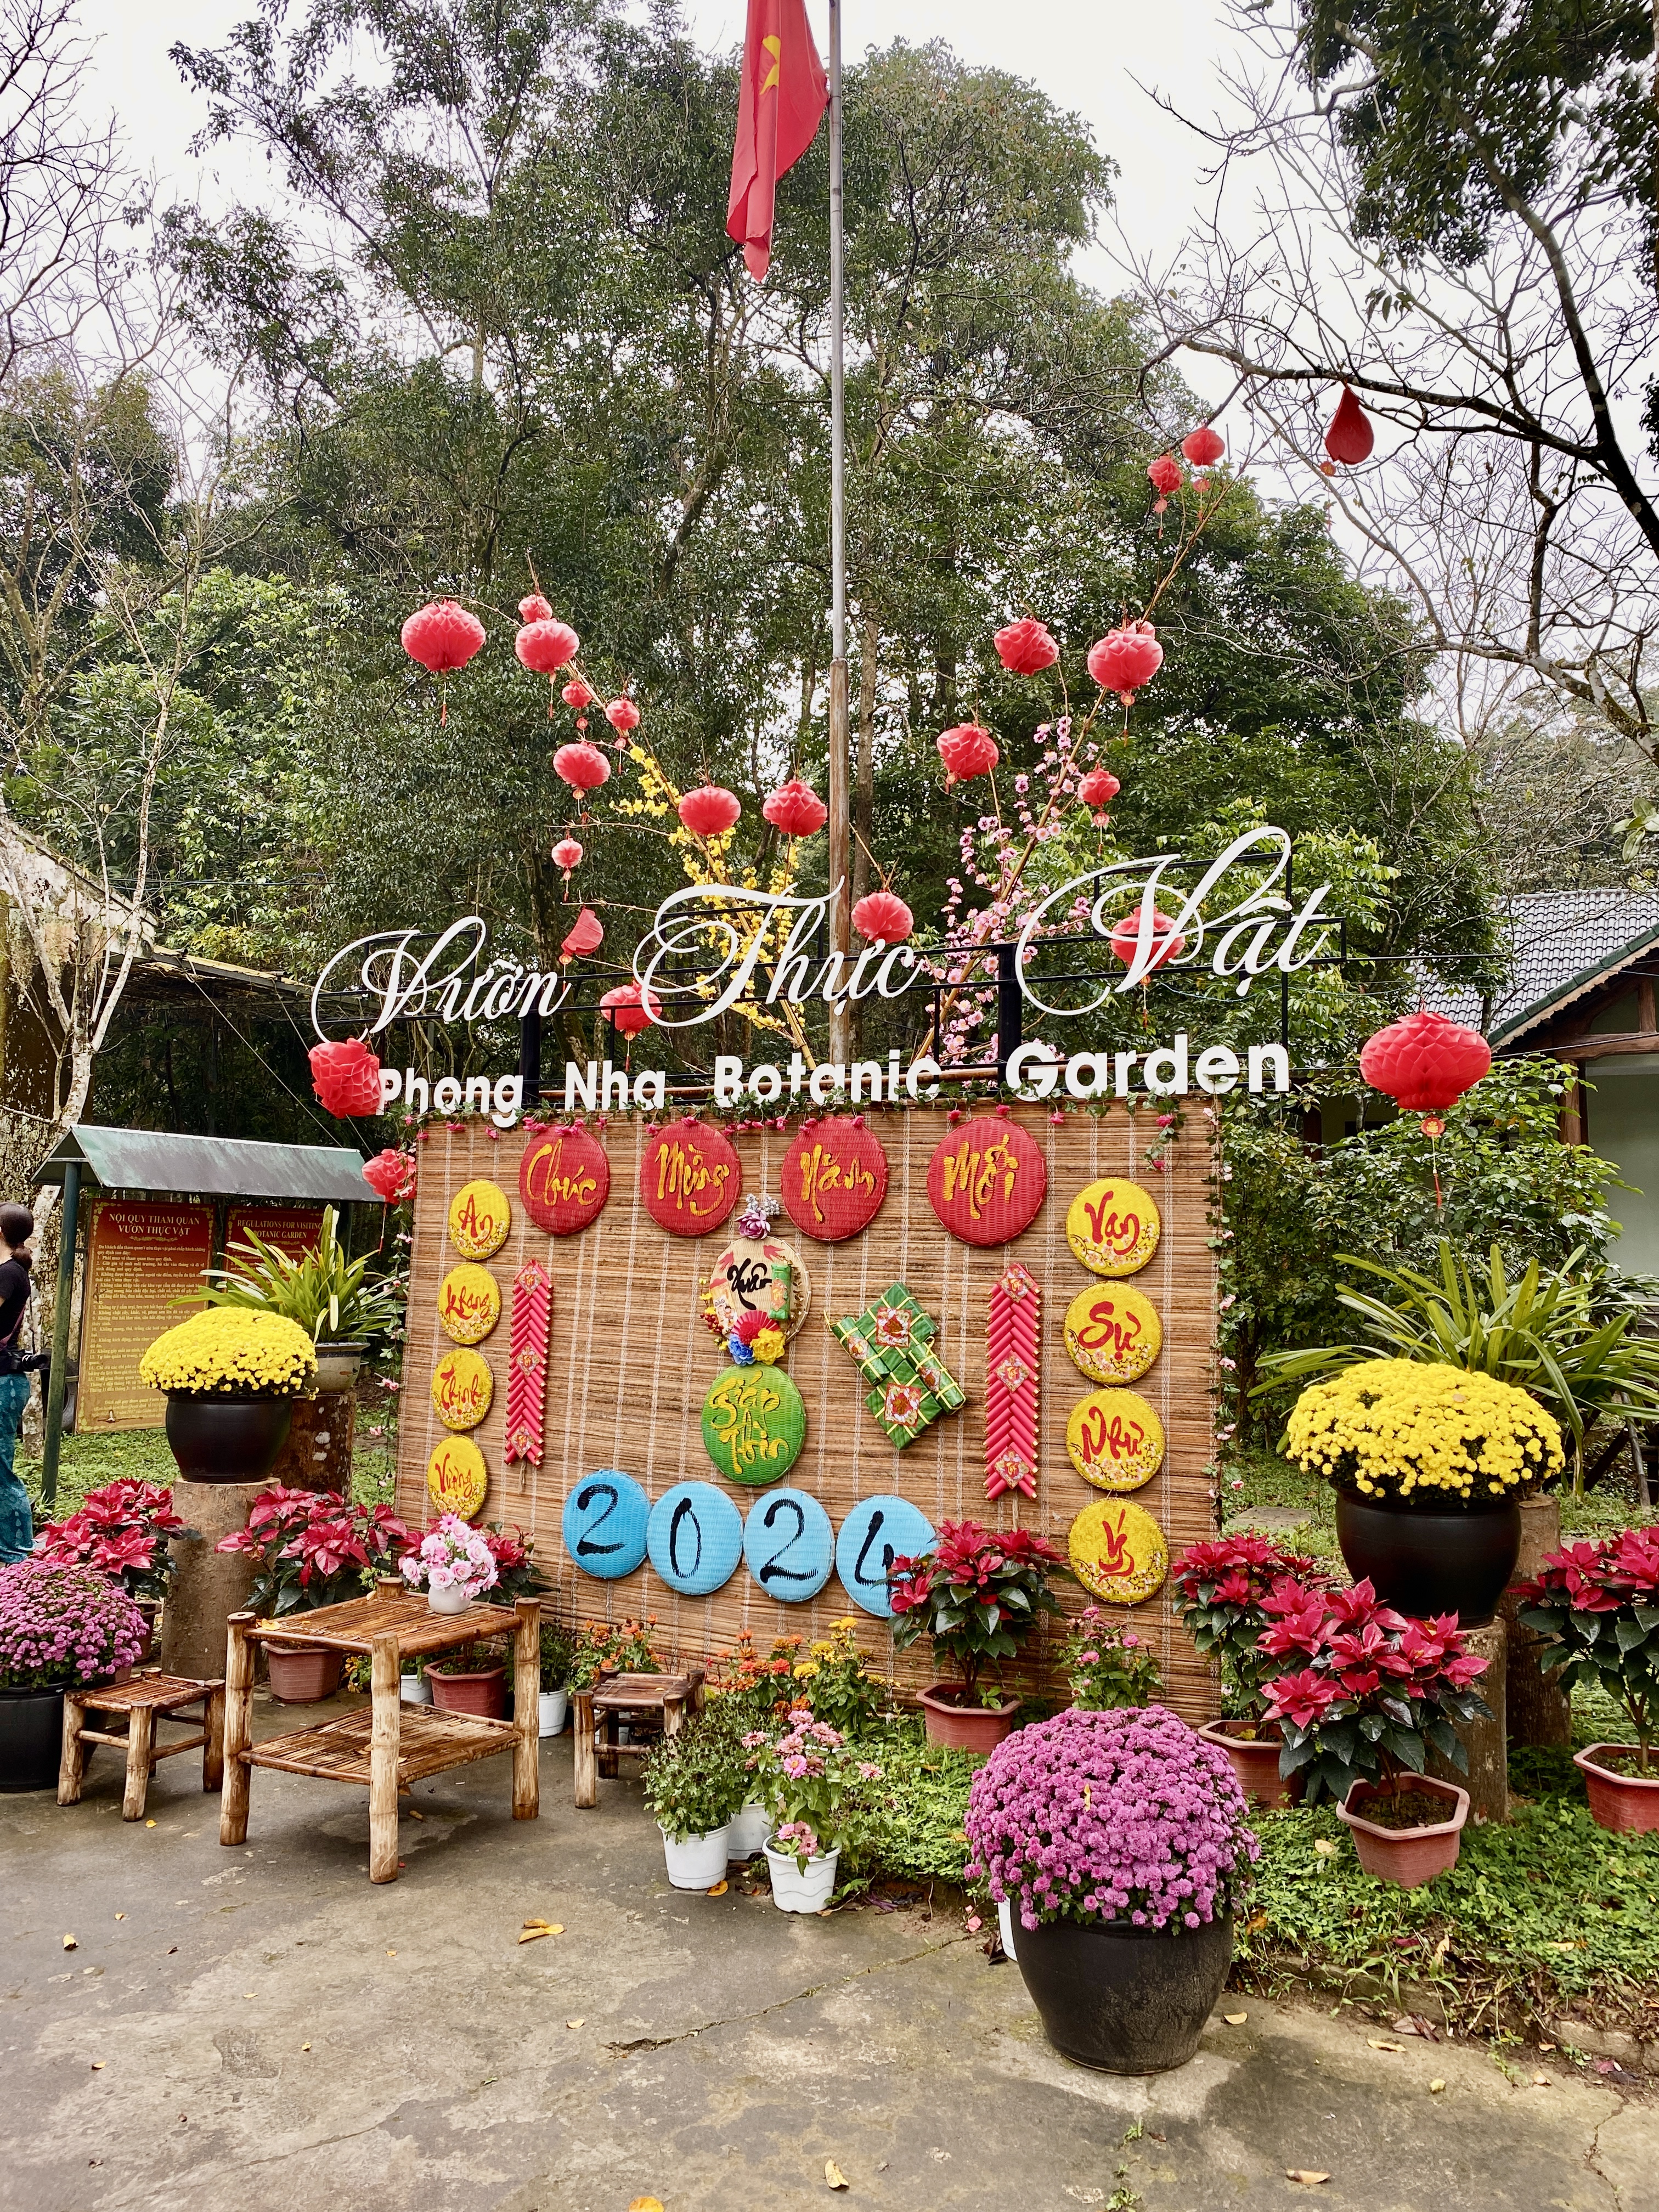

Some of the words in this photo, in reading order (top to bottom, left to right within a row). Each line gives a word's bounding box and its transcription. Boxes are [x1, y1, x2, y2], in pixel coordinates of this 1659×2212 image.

[312, 916, 572, 1042] Vườn
[633, 876, 923, 1027] Thực
[1015, 826, 1332, 1015] Vật
[379, 1068, 523, 1128] Phong
[565, 1061, 665, 1111] Nha
[714, 1049, 941, 1106] Botanic
[1006, 1034, 1289, 1099] Garden
[527, 1139, 597, 1206] Chúc
[655, 1141, 730, 1216] Mừng
[801, 1144, 876, 1223] Năm
[944, 1134, 1018, 1220] Mới
[109, 1212, 125, 1223] NỘI
[128, 1214, 146, 1224] QUY
[148, 1215, 174, 1223] THAM
[176, 1216, 200, 1226] QUAN
[119, 1223, 144, 1234] VƯỜN
[146, 1226, 171, 1236] THỰC
[173, 1226, 190, 1237] VẬT
[238, 1220, 281, 1228] REGULATIONS
[296, 1222, 323, 1230] VISITING
[458, 1194, 493, 1246] An
[1085, 1190, 1139, 1255] Vạn
[445, 1284, 489, 1320] Khang
[1079, 1301, 1141, 1360] Sự
[441, 1364, 481, 1415] Thịnh
[1081, 1406, 1144, 1464] Như
[436, 1453, 472, 1499] Vượng
[1098, 1509, 1134, 1584] Ý
